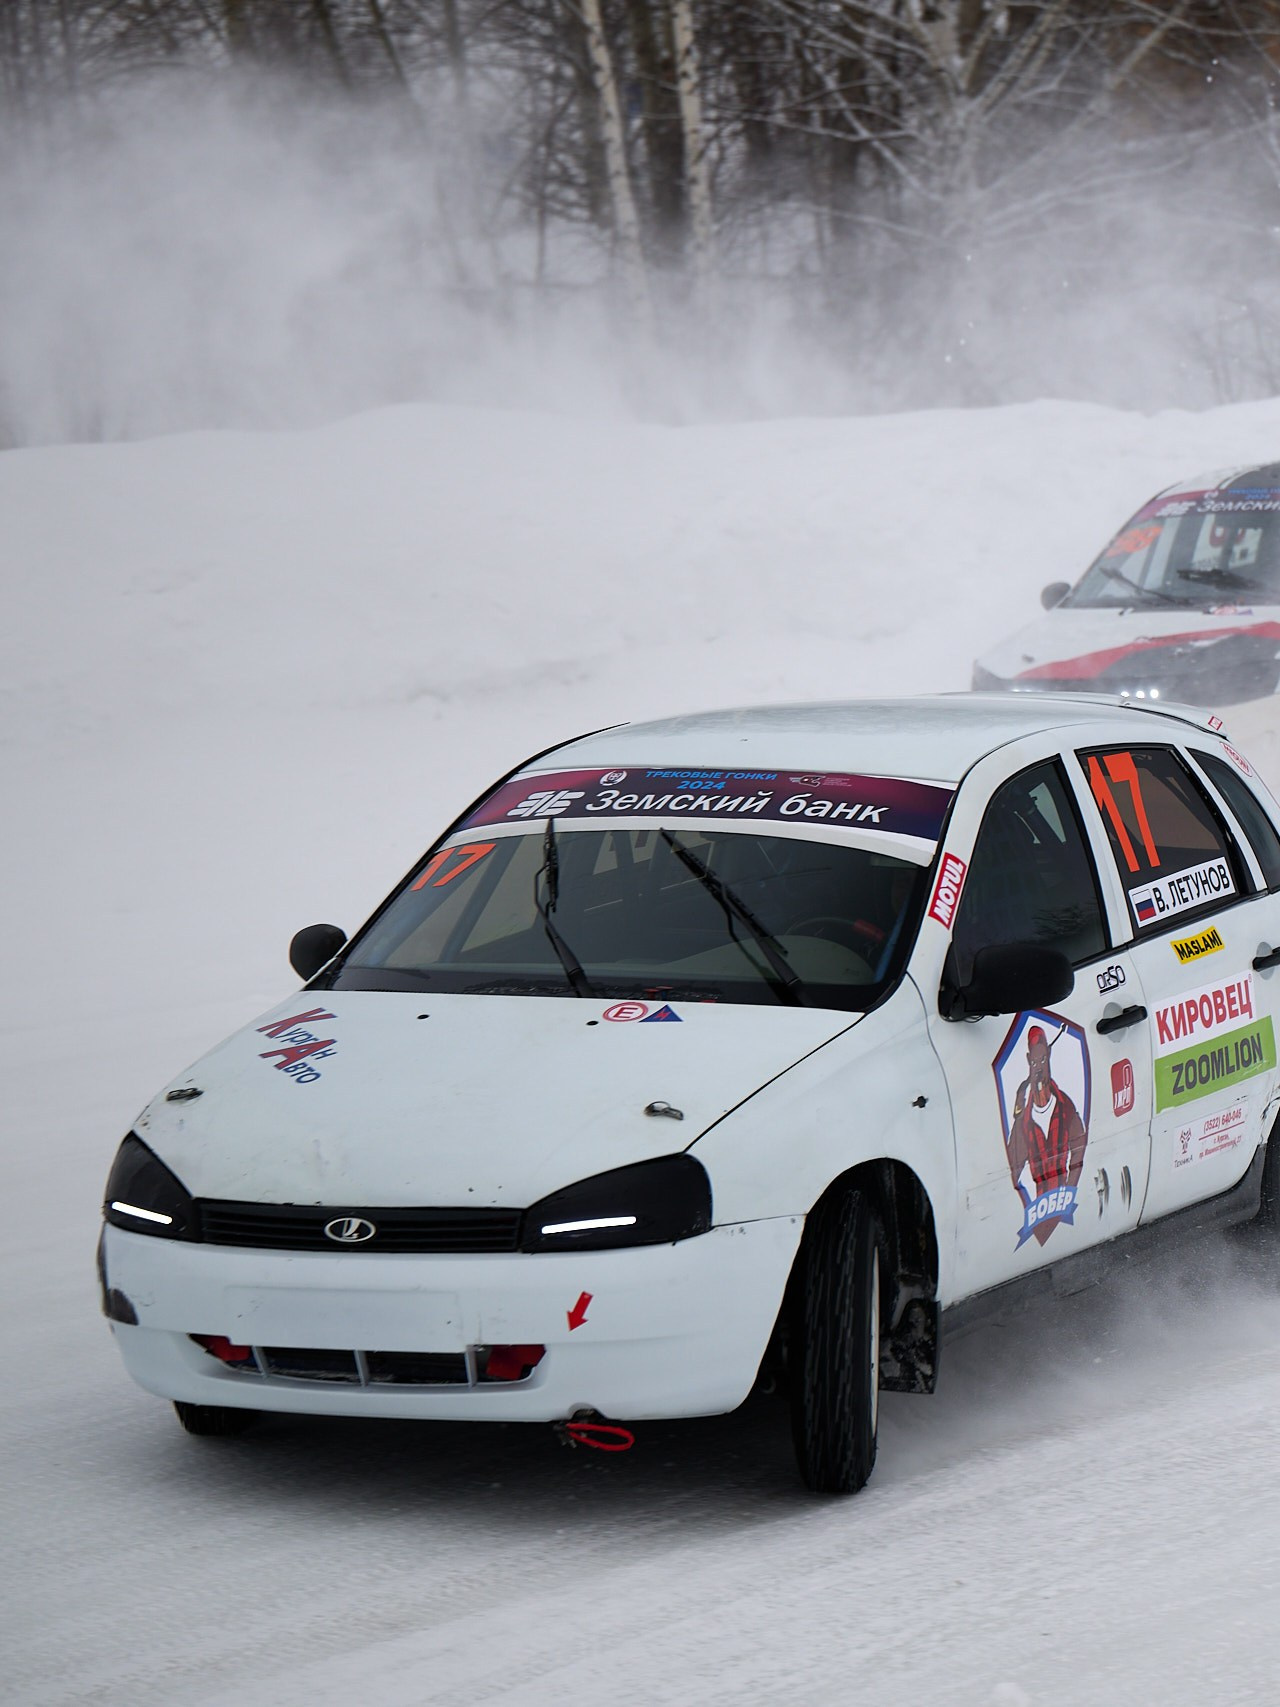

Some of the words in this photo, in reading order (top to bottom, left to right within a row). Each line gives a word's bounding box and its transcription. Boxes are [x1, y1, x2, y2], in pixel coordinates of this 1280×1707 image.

[645, 769, 724, 780] ТРЕКОВЫЕ
[725, 771, 779, 781] ГОНКИ
[676, 779, 727, 790] 2024
[585, 789, 774, 814] Земский
[779, 793, 891, 823] банк
[1088, 752, 1160, 873] 17
[410, 843, 497, 892] 17
[933, 858, 964, 926] MOTUL
[1152, 886, 1170, 913] В.
[1167, 863, 1231, 908] ЛЕТУНОВ
[1173, 929, 1223, 963] MASLAMI
[1155, 979, 1253, 1045] КИРОВЕЦ
[1172, 1033, 1263, 1096] ZOOMLION
[1027, 1186, 1073, 1228] БОБЁР
